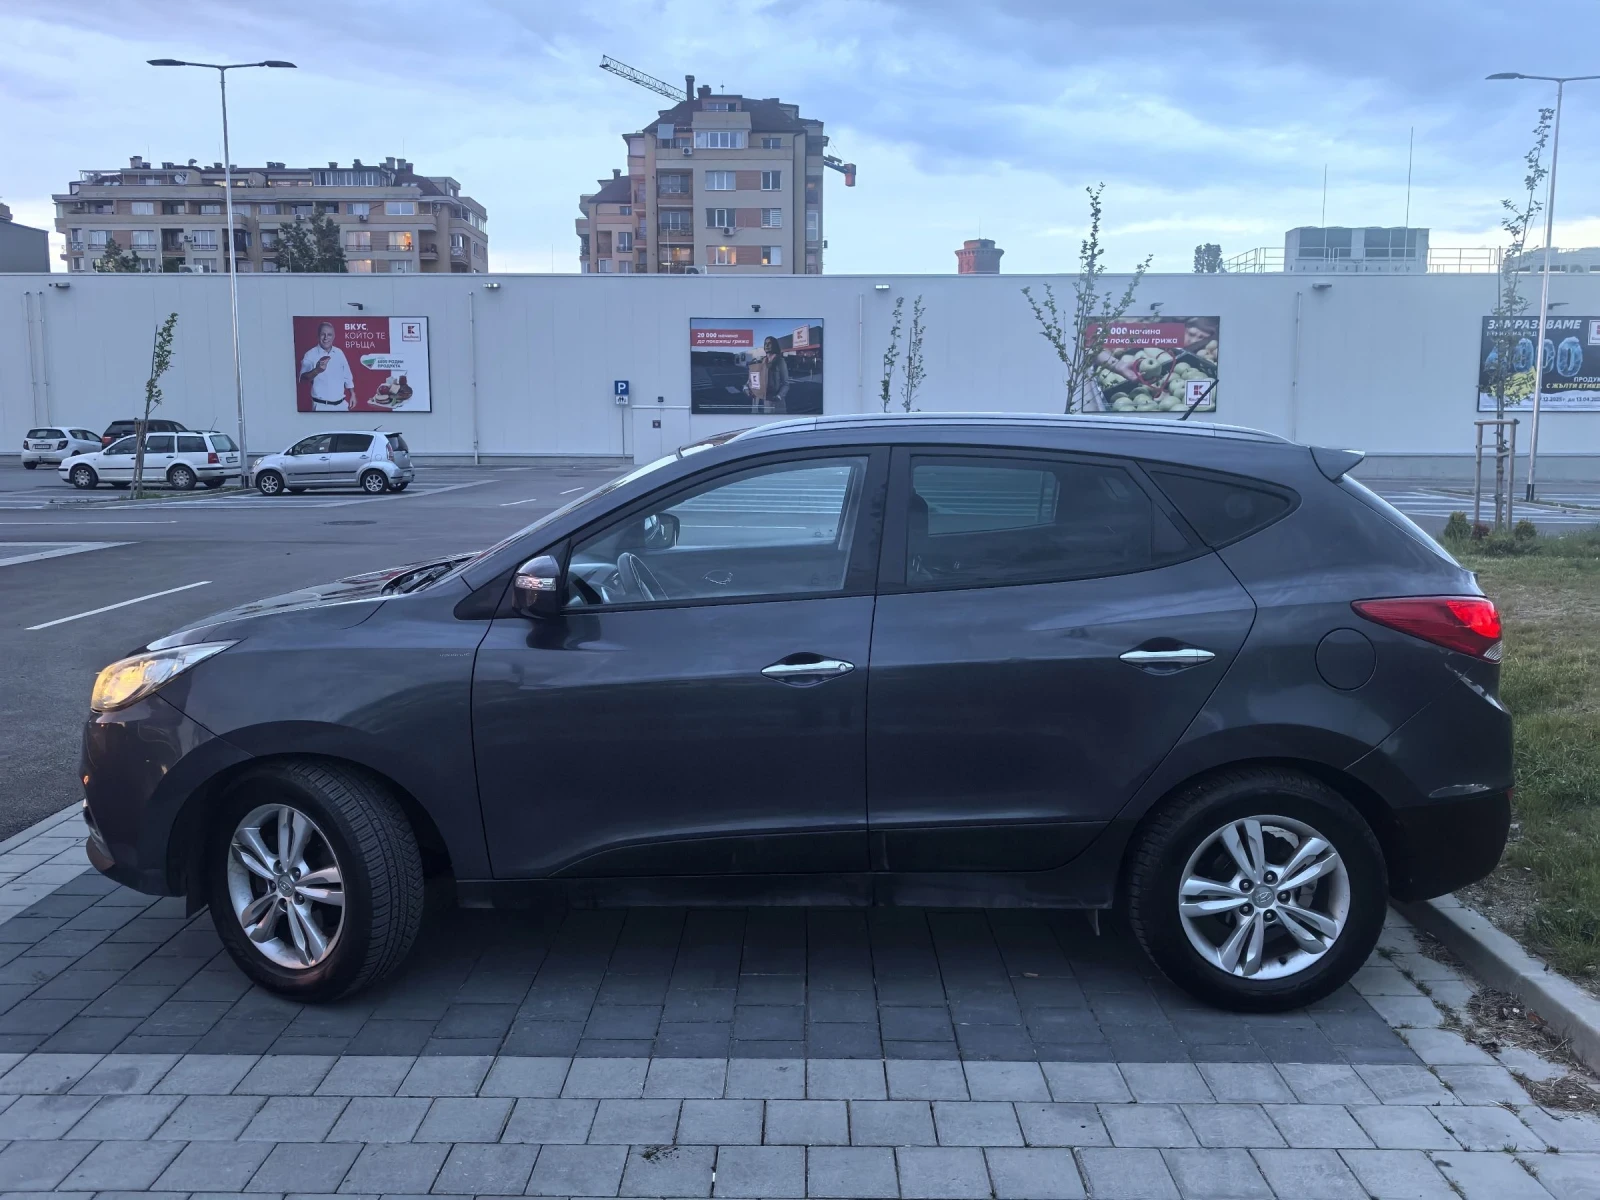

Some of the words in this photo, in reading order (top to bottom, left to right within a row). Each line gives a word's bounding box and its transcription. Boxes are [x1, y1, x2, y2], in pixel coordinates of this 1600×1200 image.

[344, 331, 374, 340] КОЙТО
[376, 332, 386, 340] ТЕ
[1110, 327, 1128, 335] 000
[345, 340, 376, 349] ВРЪЩА
[1151, 338, 1178, 346] грижа
[617, 382, 627, 394] P
